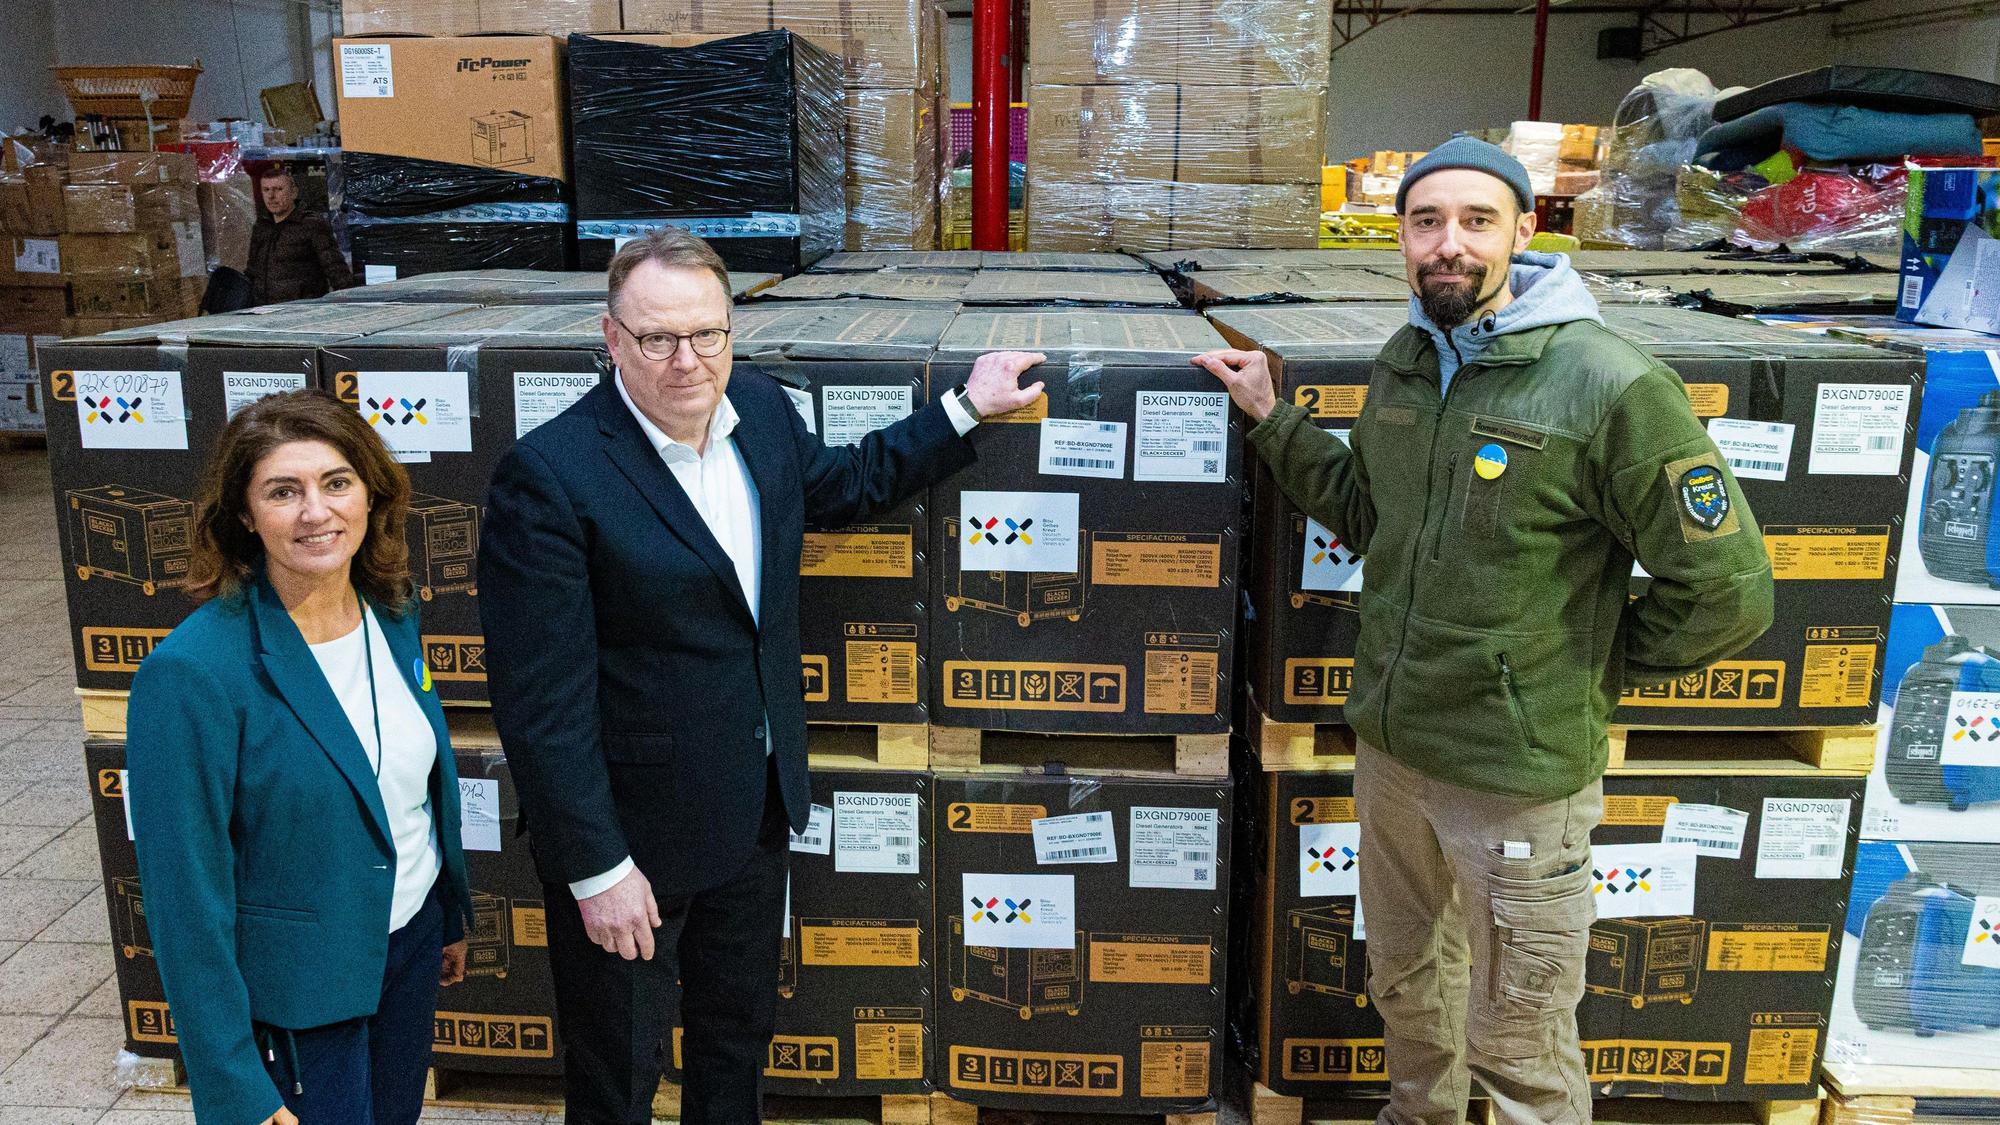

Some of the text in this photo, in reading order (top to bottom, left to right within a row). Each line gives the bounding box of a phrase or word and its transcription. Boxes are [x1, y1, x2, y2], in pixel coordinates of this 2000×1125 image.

[1802, 182, 1816, 213] Gut.
[56, 373, 75, 397] 2
[228, 378, 300, 388] BXGND7900E
[340, 374, 358, 400] 2
[518, 376, 593, 387] BXGND7900E
[827, 390, 905, 400] BXGND7900E
[1142, 396, 1224, 406] BXGND7900E
[1302, 388, 1320, 414] 2
[1822, 389, 1904, 400] BXGND7900E
[1692, 483, 1714, 492] Kreuz
[98, 638, 110, 653] 3
[960, 672, 974, 688] 3
[1302, 670, 1316, 685] 3
[104, 772, 122, 794] 2
[838, 796, 912, 806] BXGND7900E
[953, 806, 972, 828] 2
[1135, 810, 1212, 821] BXGND7900E
[1296, 800, 1314, 822] 2
[1122, 935, 1179, 943] SPECIFACTIONS
[142, 1011, 155, 1025] 3
[1300, 1050, 1312, 1064] 3
[966, 1057, 979, 1072] 3
